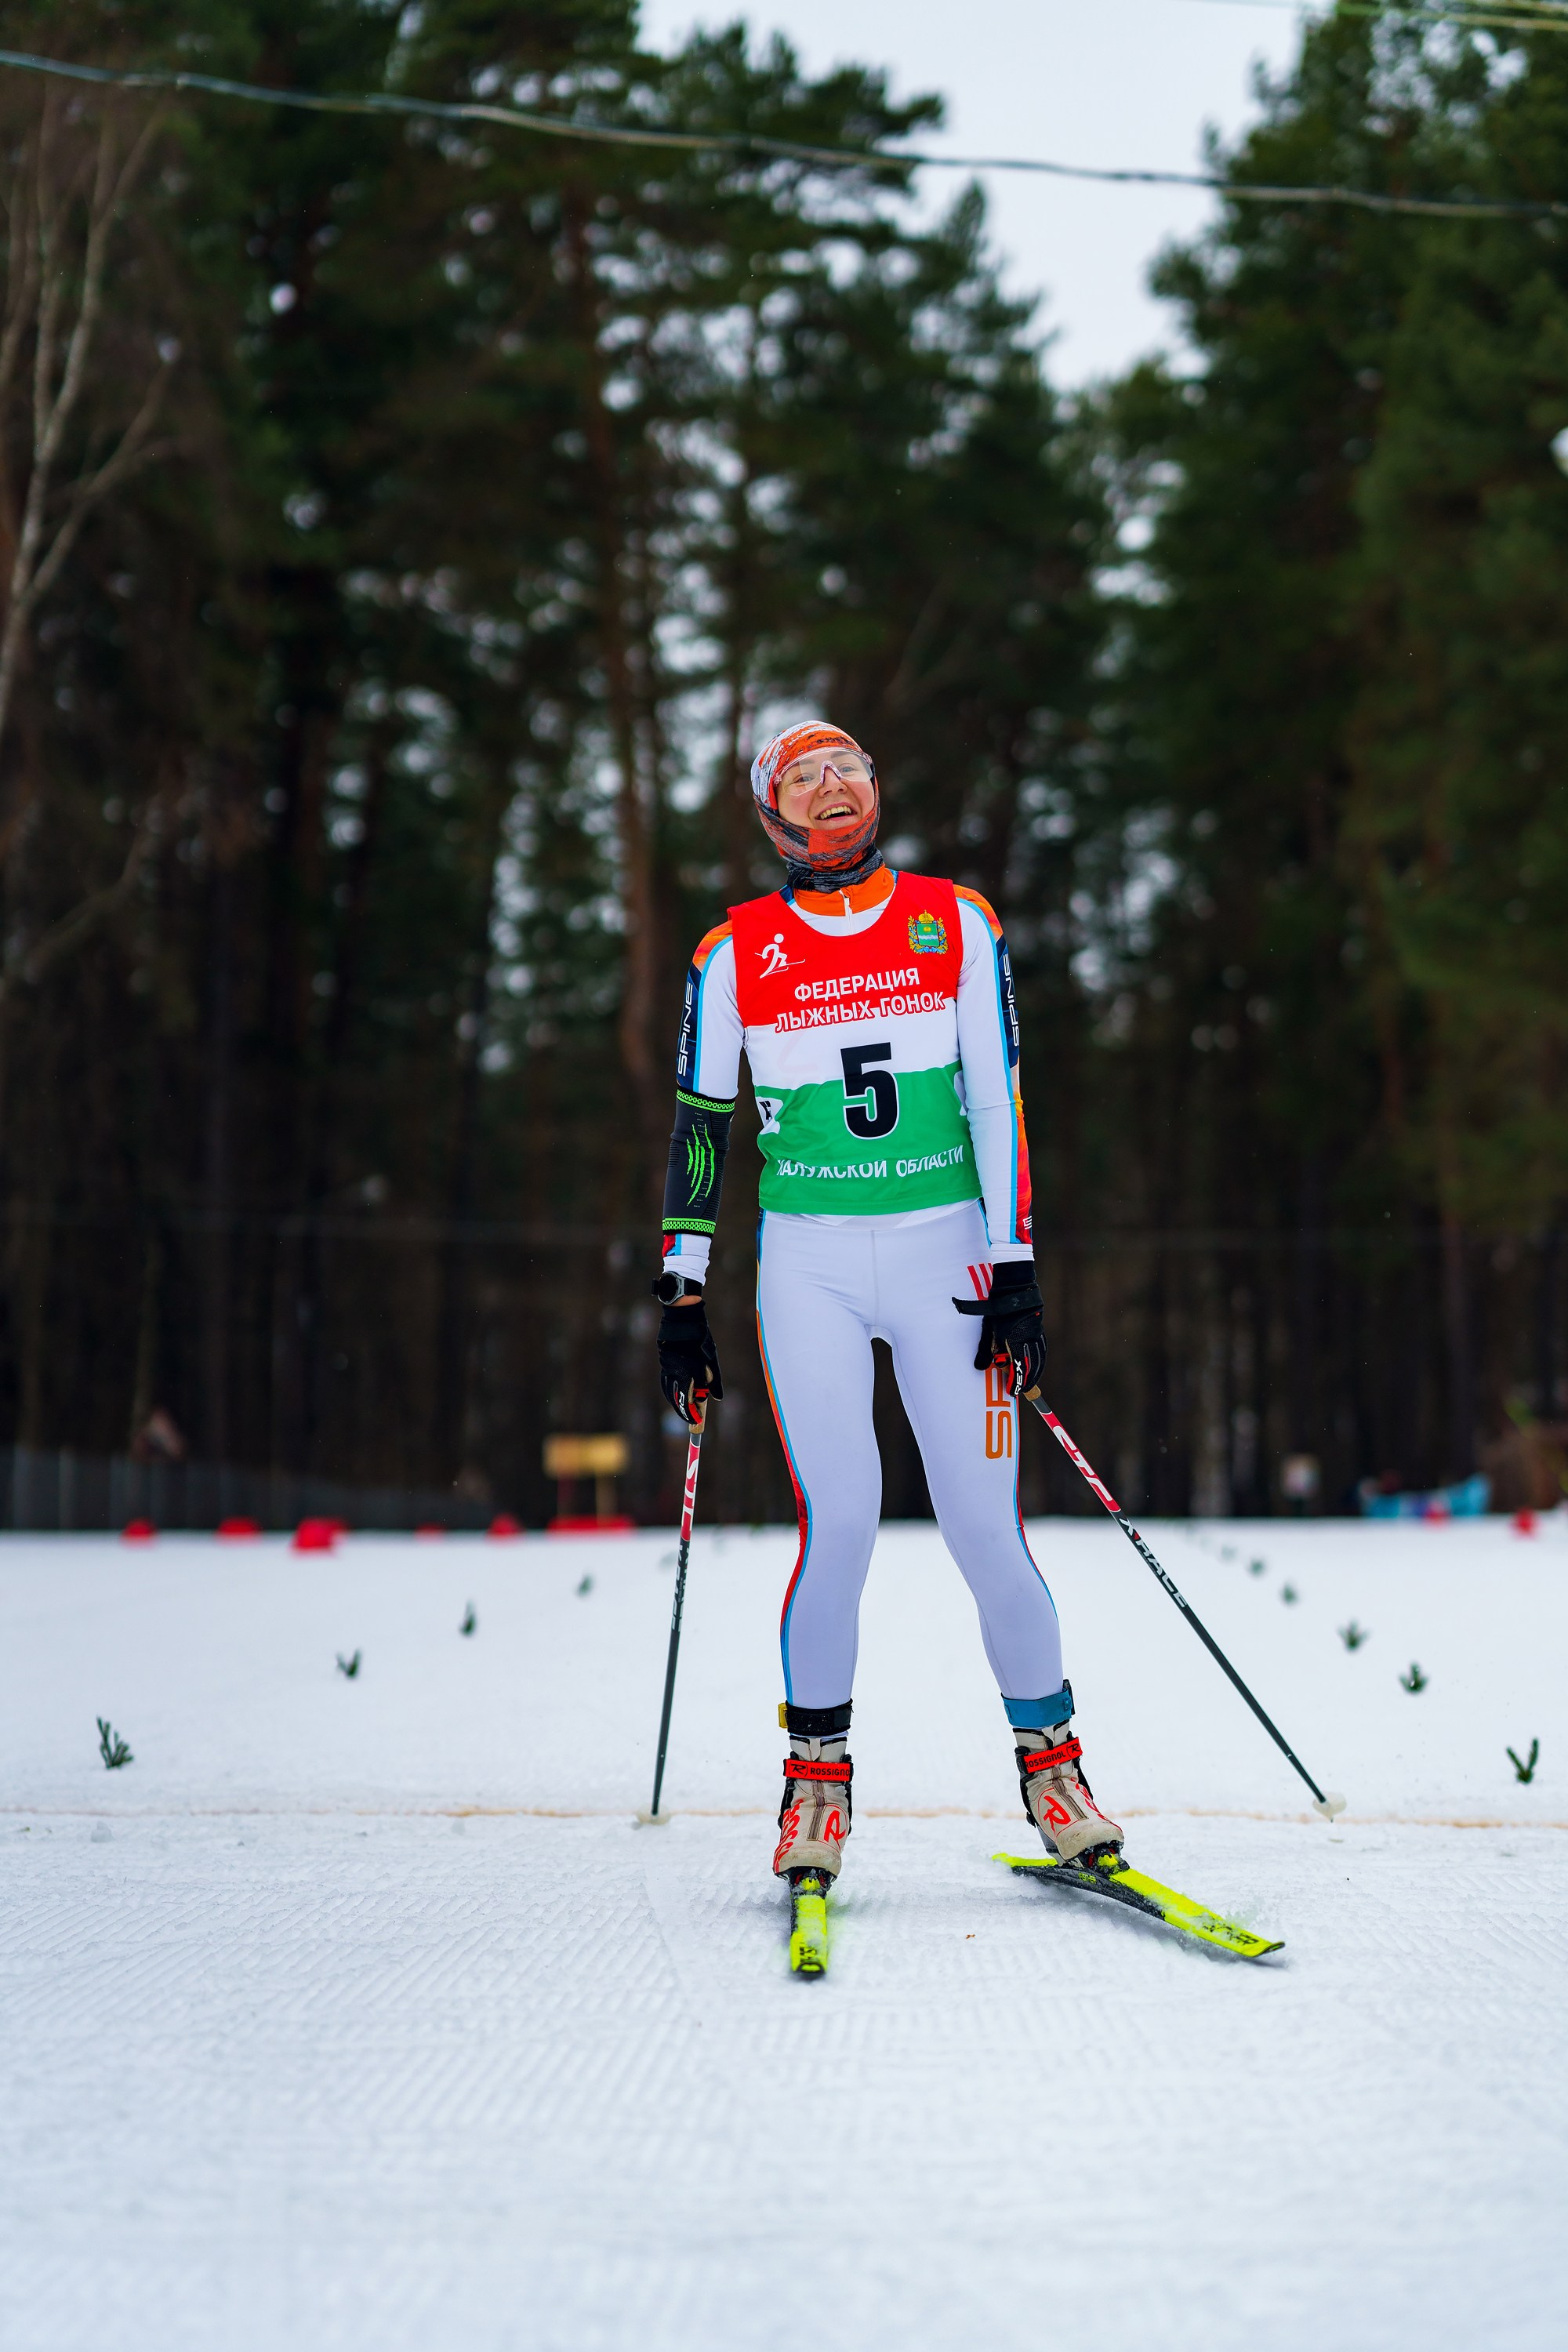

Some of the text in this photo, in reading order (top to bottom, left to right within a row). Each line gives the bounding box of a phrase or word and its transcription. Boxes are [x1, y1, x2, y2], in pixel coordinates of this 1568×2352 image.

[794, 967, 920, 1002] ФЕДЕРАЦИЯ
[1004, 953, 1019, 1047] SPINE
[677, 982, 693, 1077] SPINE
[775, 991, 946, 1033] ЛЫЖНЫХ ГОНОК
[840, 1041, 900, 1139] 5
[895, 1145, 964, 1178] ОБЛАСТИ
[1014, 1359, 1023, 1396] REX
[810, 1766, 850, 1777] ROSSIGNO
